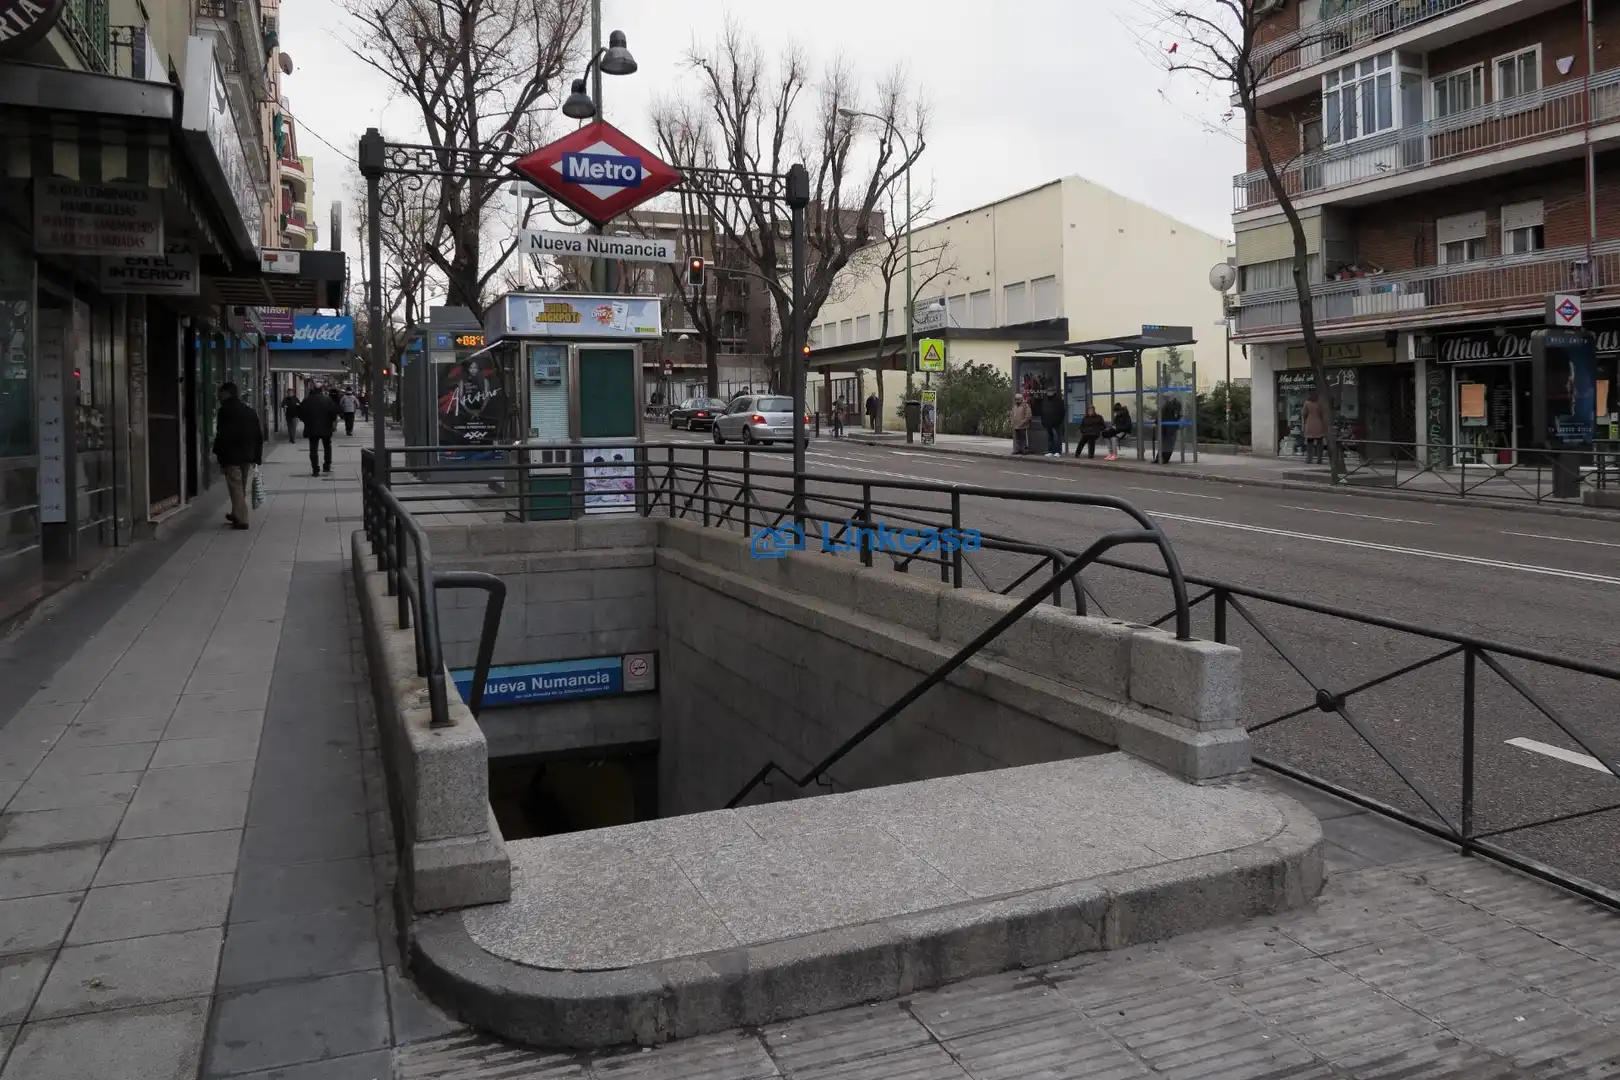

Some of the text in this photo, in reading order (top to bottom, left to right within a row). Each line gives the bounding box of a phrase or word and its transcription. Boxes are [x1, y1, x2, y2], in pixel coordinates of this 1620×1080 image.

[569, 156, 636, 181] Metro
[530, 234, 667, 258] Nueva Numancia
[124, 257, 174, 268] EN EL
[109, 266, 191, 281] INTERIOR
[1441, 338, 1490, 361] Uñas
[463, 431, 488, 439] AXN
[531, 671, 610, 690] Numancia
